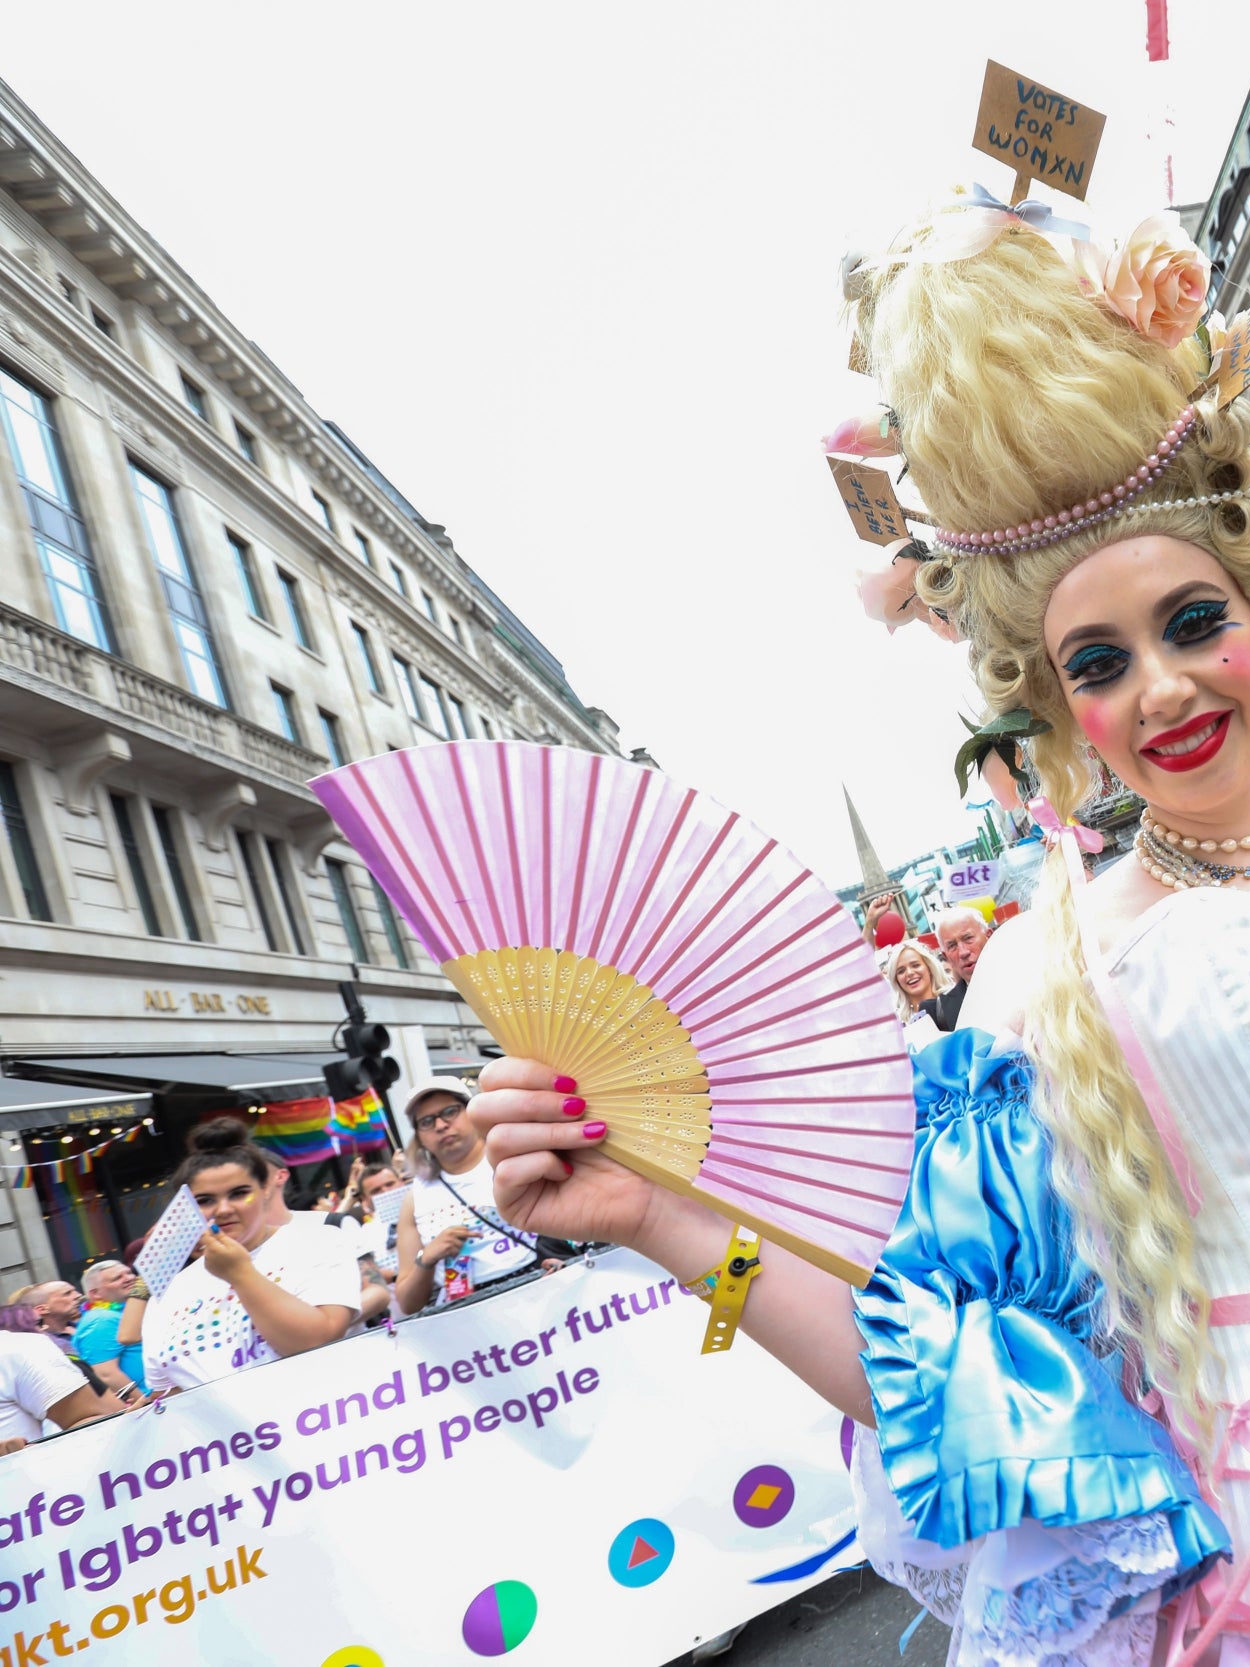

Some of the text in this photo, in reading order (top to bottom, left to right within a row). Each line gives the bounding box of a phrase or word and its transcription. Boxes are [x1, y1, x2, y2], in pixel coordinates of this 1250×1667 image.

[1017, 79, 1079, 126] VOTES
[1015, 108, 1053, 143] FOR
[988, 124, 1085, 186] WOMXN
[845, 499, 861, 512] I
[850, 478, 883, 535] BELIEVE
[874, 498, 900, 536] HER
[950, 864, 990, 886] akt
[144, 989, 271, 1015] ALL BAR ONE
[98, 1421, 282, 1510] homes
[296, 1370, 406, 1436] and
[417, 1325, 557, 1397] better
[58, 1493, 243, 1592] lgbtq+
[252, 1428, 427, 1528] young
[439, 1366, 600, 1459] people
